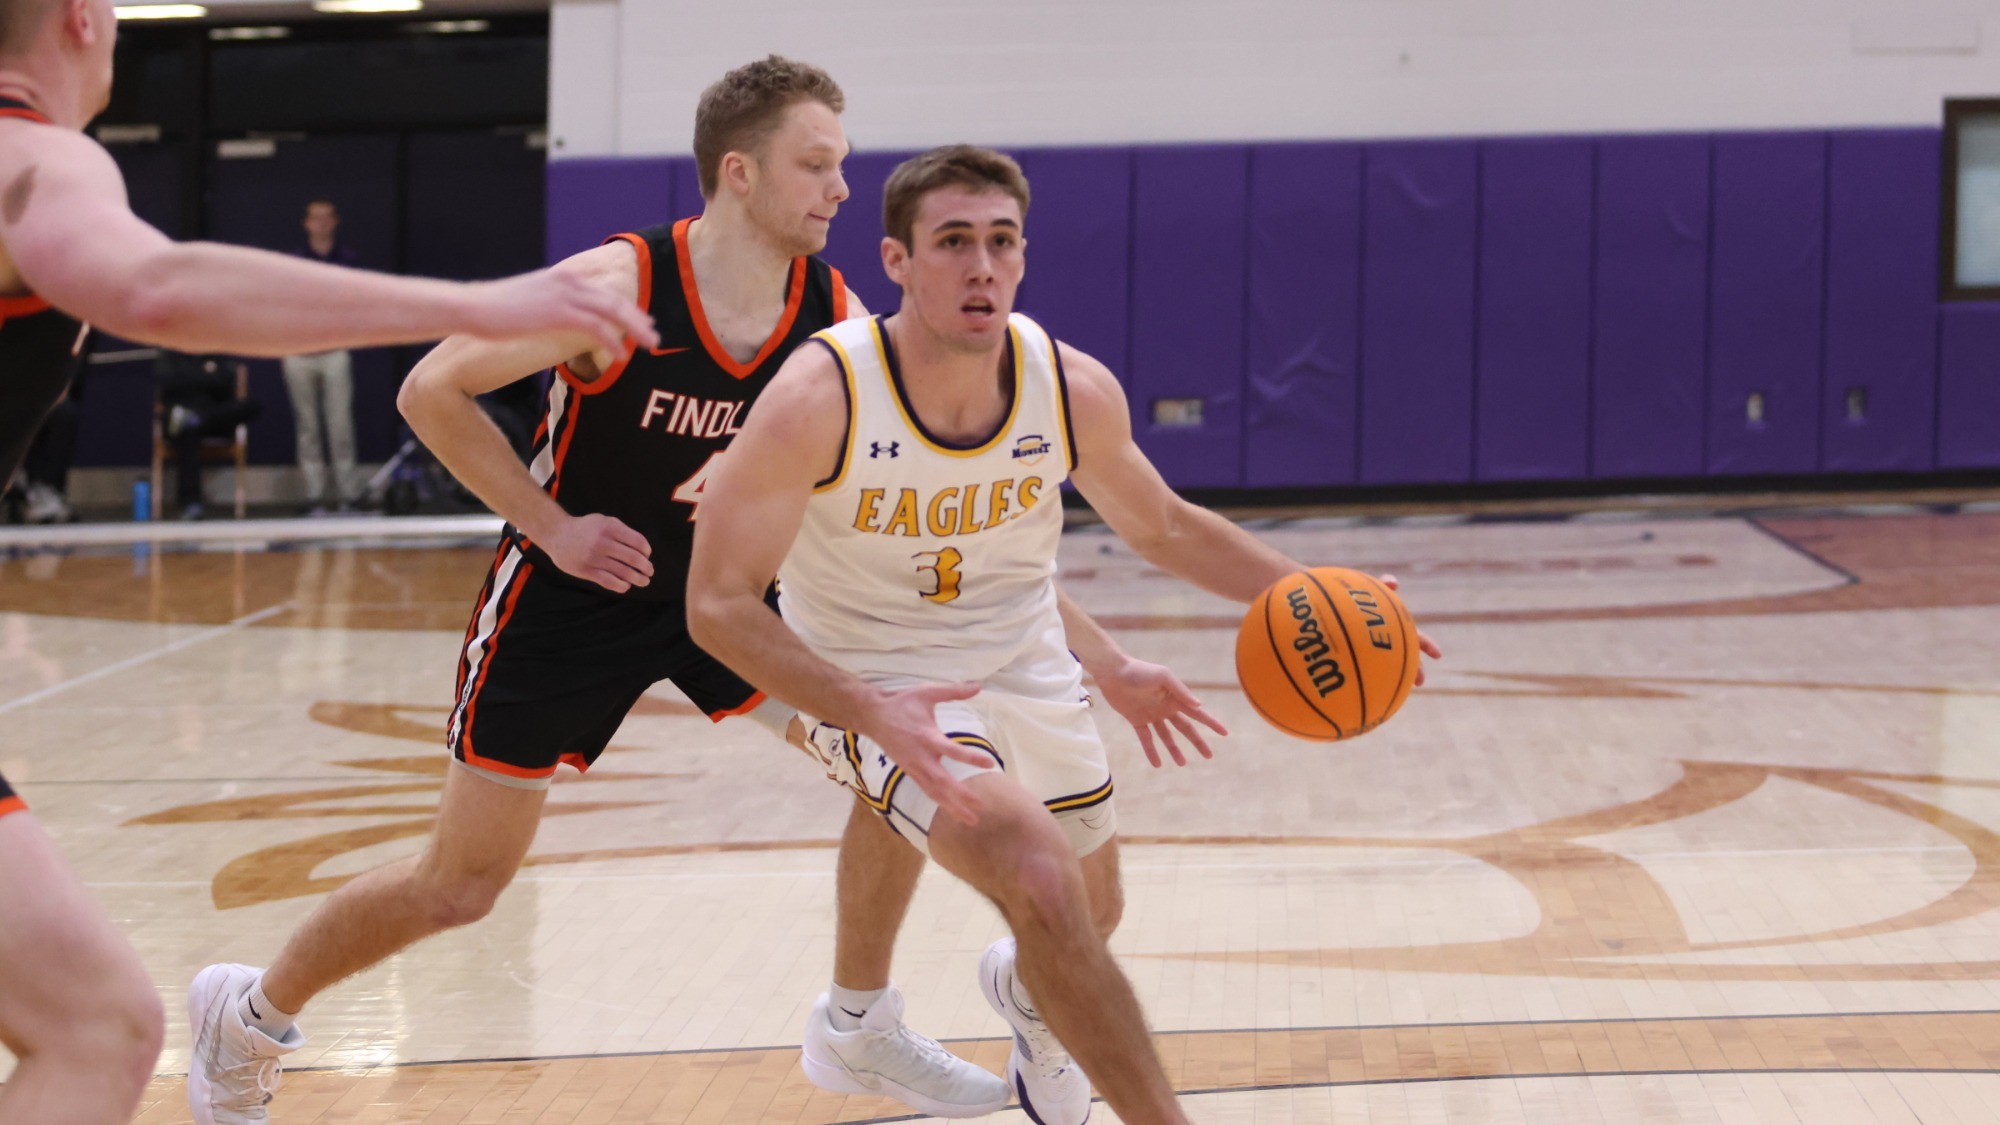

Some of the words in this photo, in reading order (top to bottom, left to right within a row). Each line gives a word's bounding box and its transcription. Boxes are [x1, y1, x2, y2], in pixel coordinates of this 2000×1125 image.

[852, 476, 1043, 537] EAGLES
[911, 546, 963, 604] 3
[1286, 587, 1346, 699] Wilson
